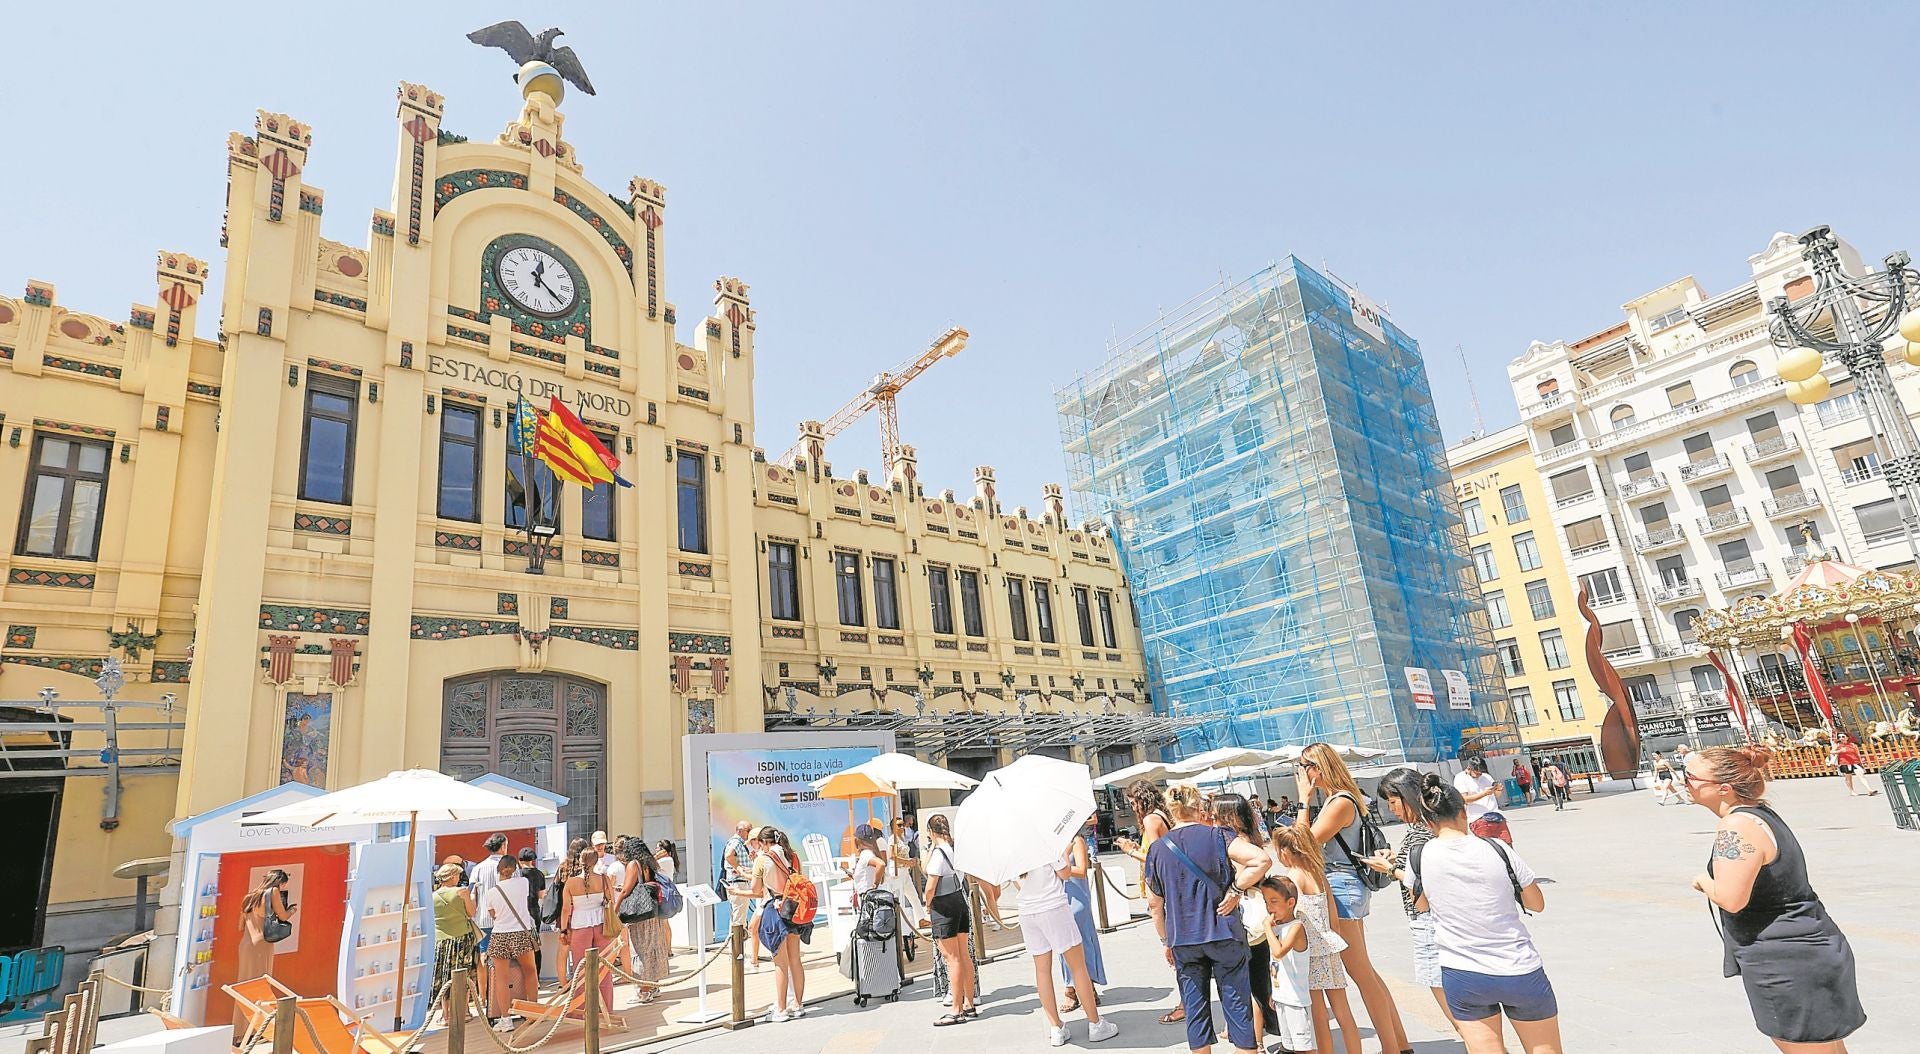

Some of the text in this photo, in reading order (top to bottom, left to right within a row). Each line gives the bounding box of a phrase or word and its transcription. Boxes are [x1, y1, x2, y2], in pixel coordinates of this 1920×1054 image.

[428, 354, 631, 417] ESTACIÓ DEL NORD
[1638, 721, 1665, 733] CHANG
[1666, 720, 1676, 729] FU
[757, 759, 843, 773] ISDIN, toda la vida
[737, 774, 800, 788] protegiendo
[802, 772, 812, 782] tu
[240, 827, 271, 838] LOVE
[274, 825, 307, 835] YOUR
